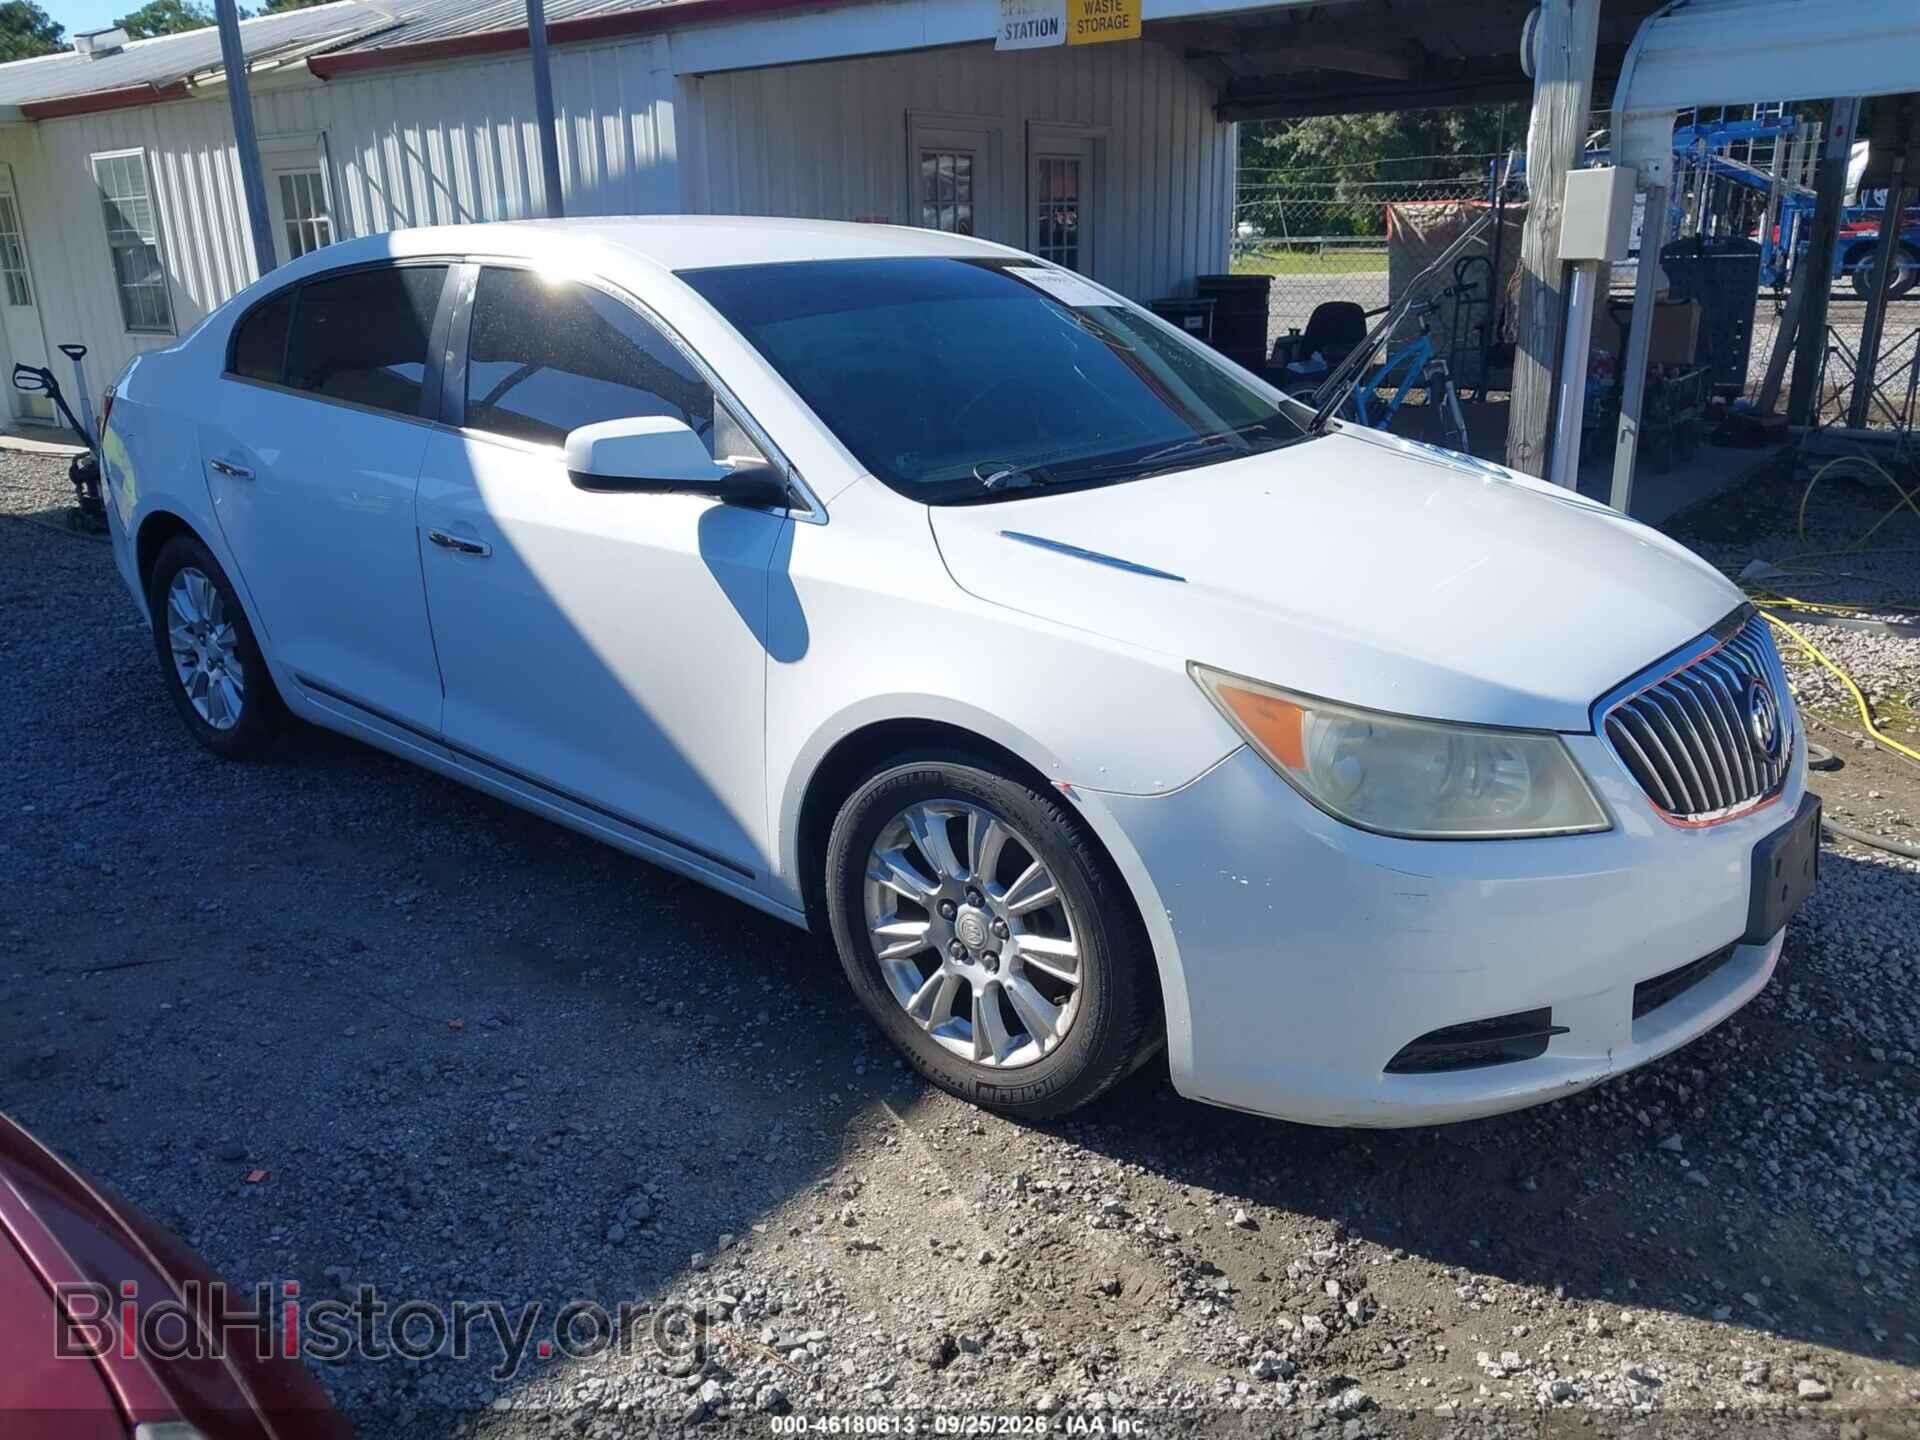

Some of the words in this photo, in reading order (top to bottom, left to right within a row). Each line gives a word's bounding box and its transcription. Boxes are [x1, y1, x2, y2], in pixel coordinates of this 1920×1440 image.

[1084, 0, 1123, 16] WASTE
[1005, 17, 1058, 41] STATION
[1077, 14, 1129, 34] STORAGE
